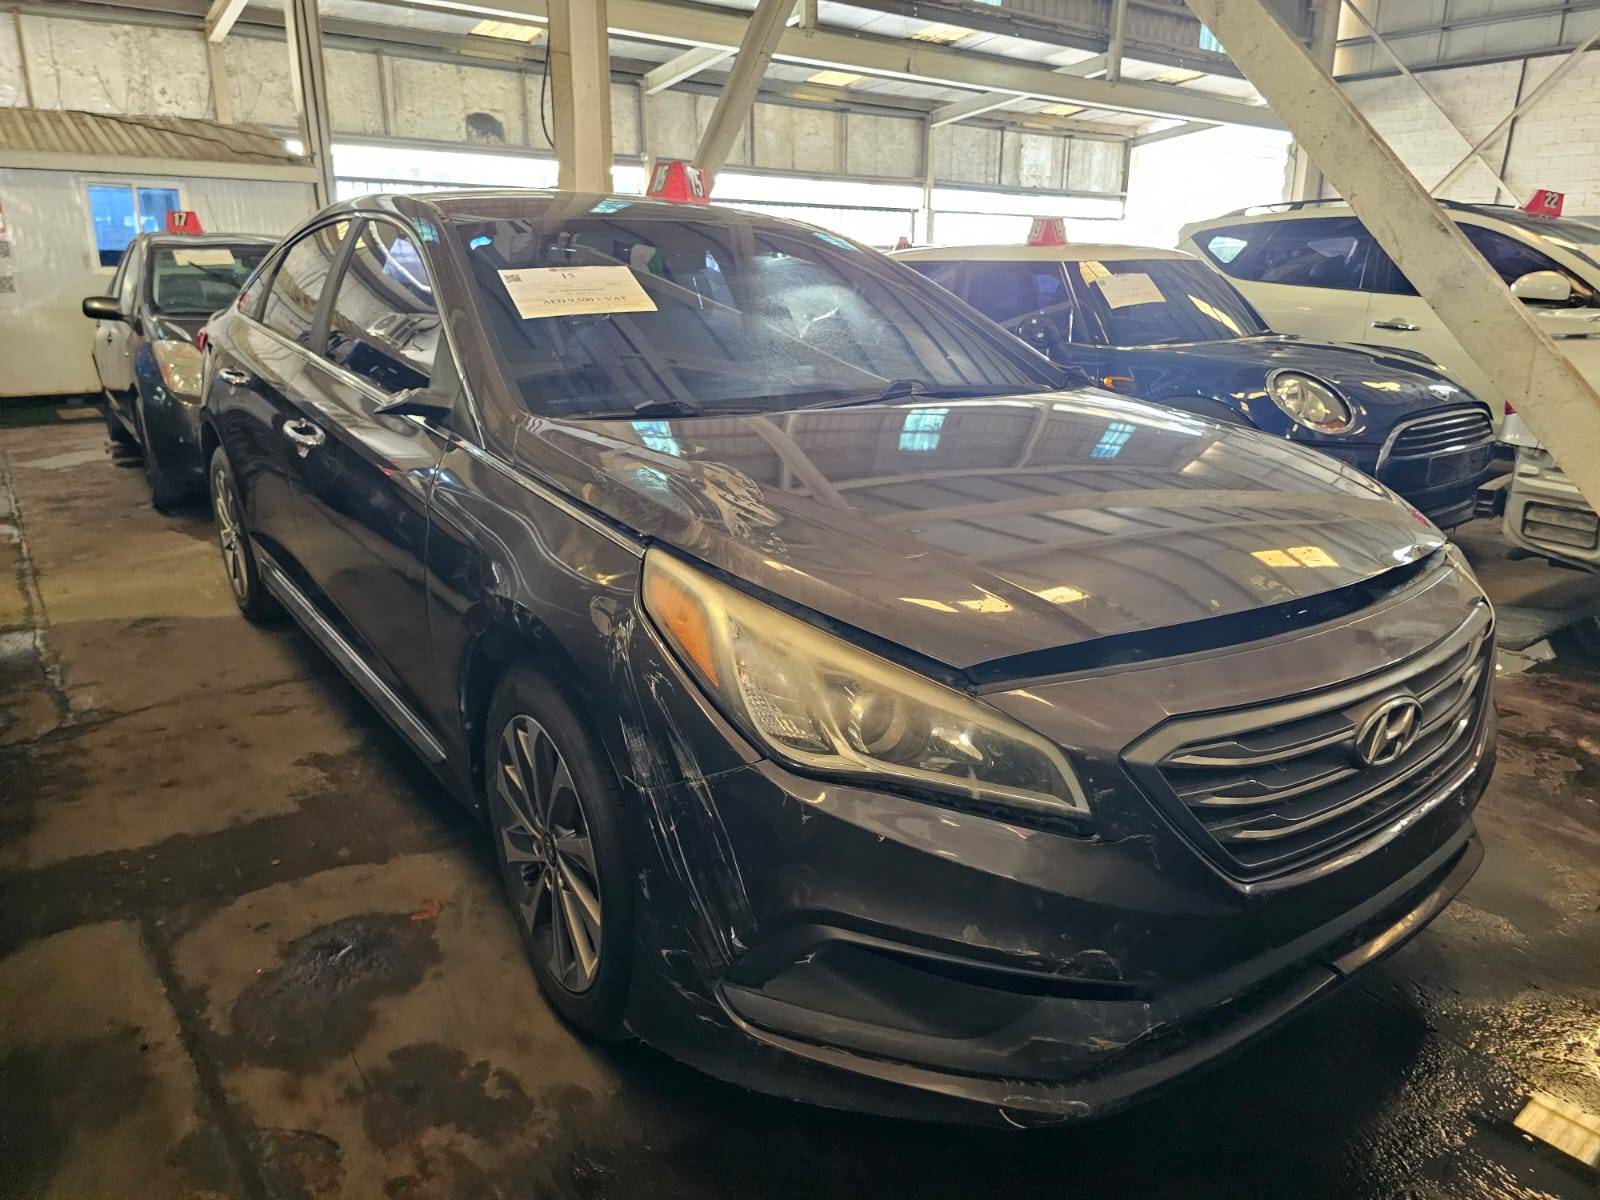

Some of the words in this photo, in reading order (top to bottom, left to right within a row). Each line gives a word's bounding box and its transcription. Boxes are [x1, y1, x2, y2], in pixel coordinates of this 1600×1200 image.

[686, 166, 704, 197] 15
[1543, 191, 1559, 209] 22
[173, 212, 187, 226] 17
[561, 272, 576, 280] 15
